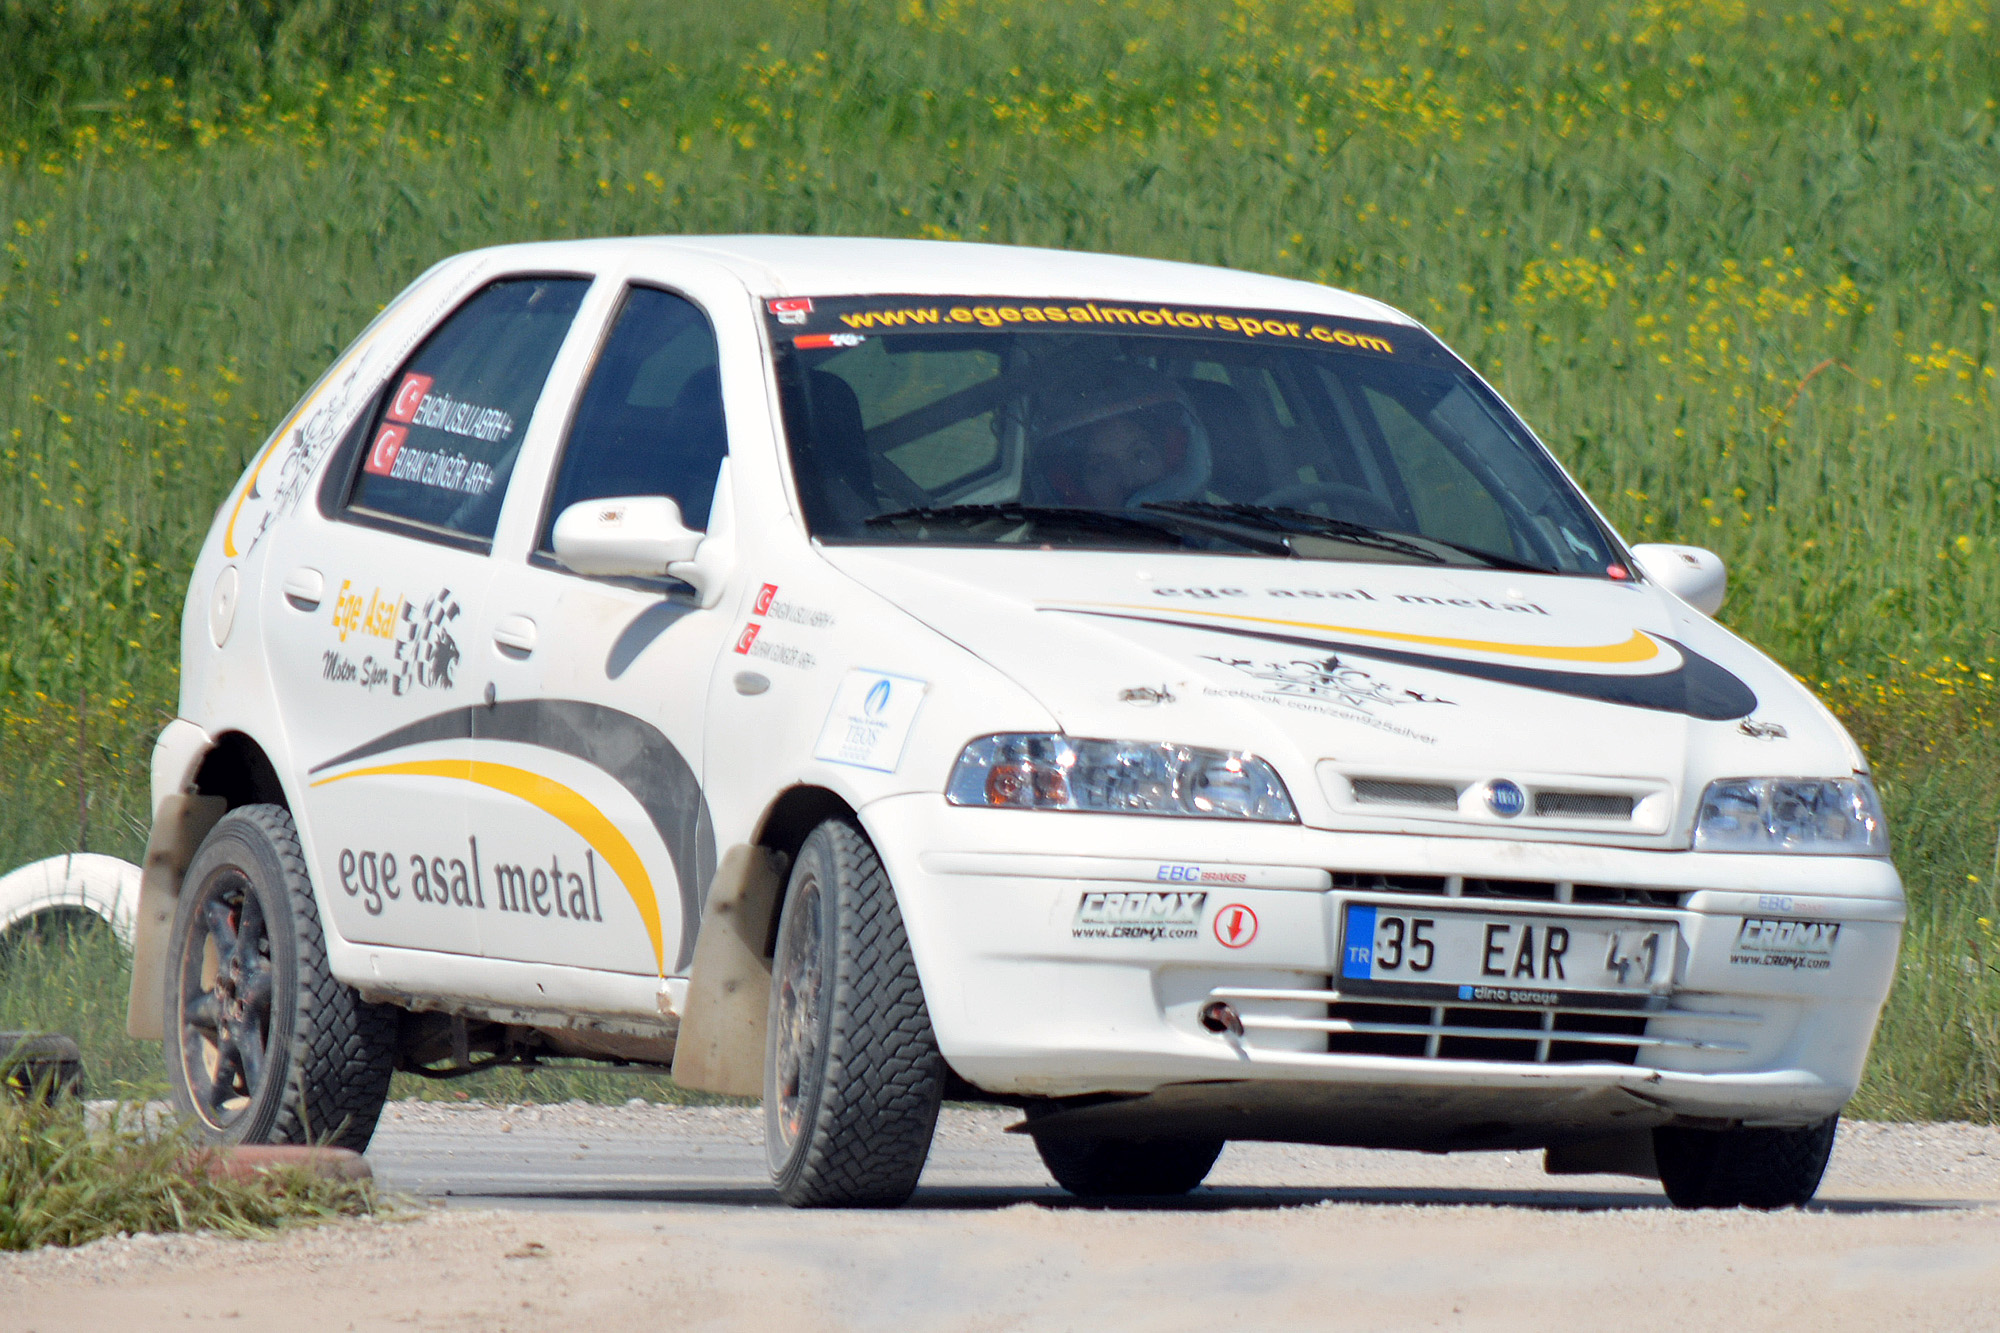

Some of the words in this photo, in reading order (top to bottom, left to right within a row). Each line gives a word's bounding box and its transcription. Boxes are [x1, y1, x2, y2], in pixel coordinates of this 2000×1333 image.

[840, 303, 1394, 354] www.egeasalmotorspor.com
[332, 579, 363, 643] Ege
[362, 586, 404, 640] Asal
[1152, 585, 1248, 599] ege
[1266, 587, 1378, 602] asal
[1394, 592, 1552, 617] metal
[322, 649, 357, 681] Motor
[360, 655, 389, 692] Spor
[338, 847, 401, 917] ege
[409, 834, 486, 910] asal
[494, 848, 603, 923] metal
[1156, 864, 1200, 882] EBC
[1078, 892, 1208, 921] CROMX
[1758, 895, 1793, 912] EBC
[1071, 926, 1199, 942] www.CROMX.com
[1348, 946, 1370, 965] TR
[1376, 915, 1435, 973] 35
[1480, 922, 1570, 981] EAR
[1604, 928, 1660, 985] 41
[1474, 986, 1508, 1001] dino
